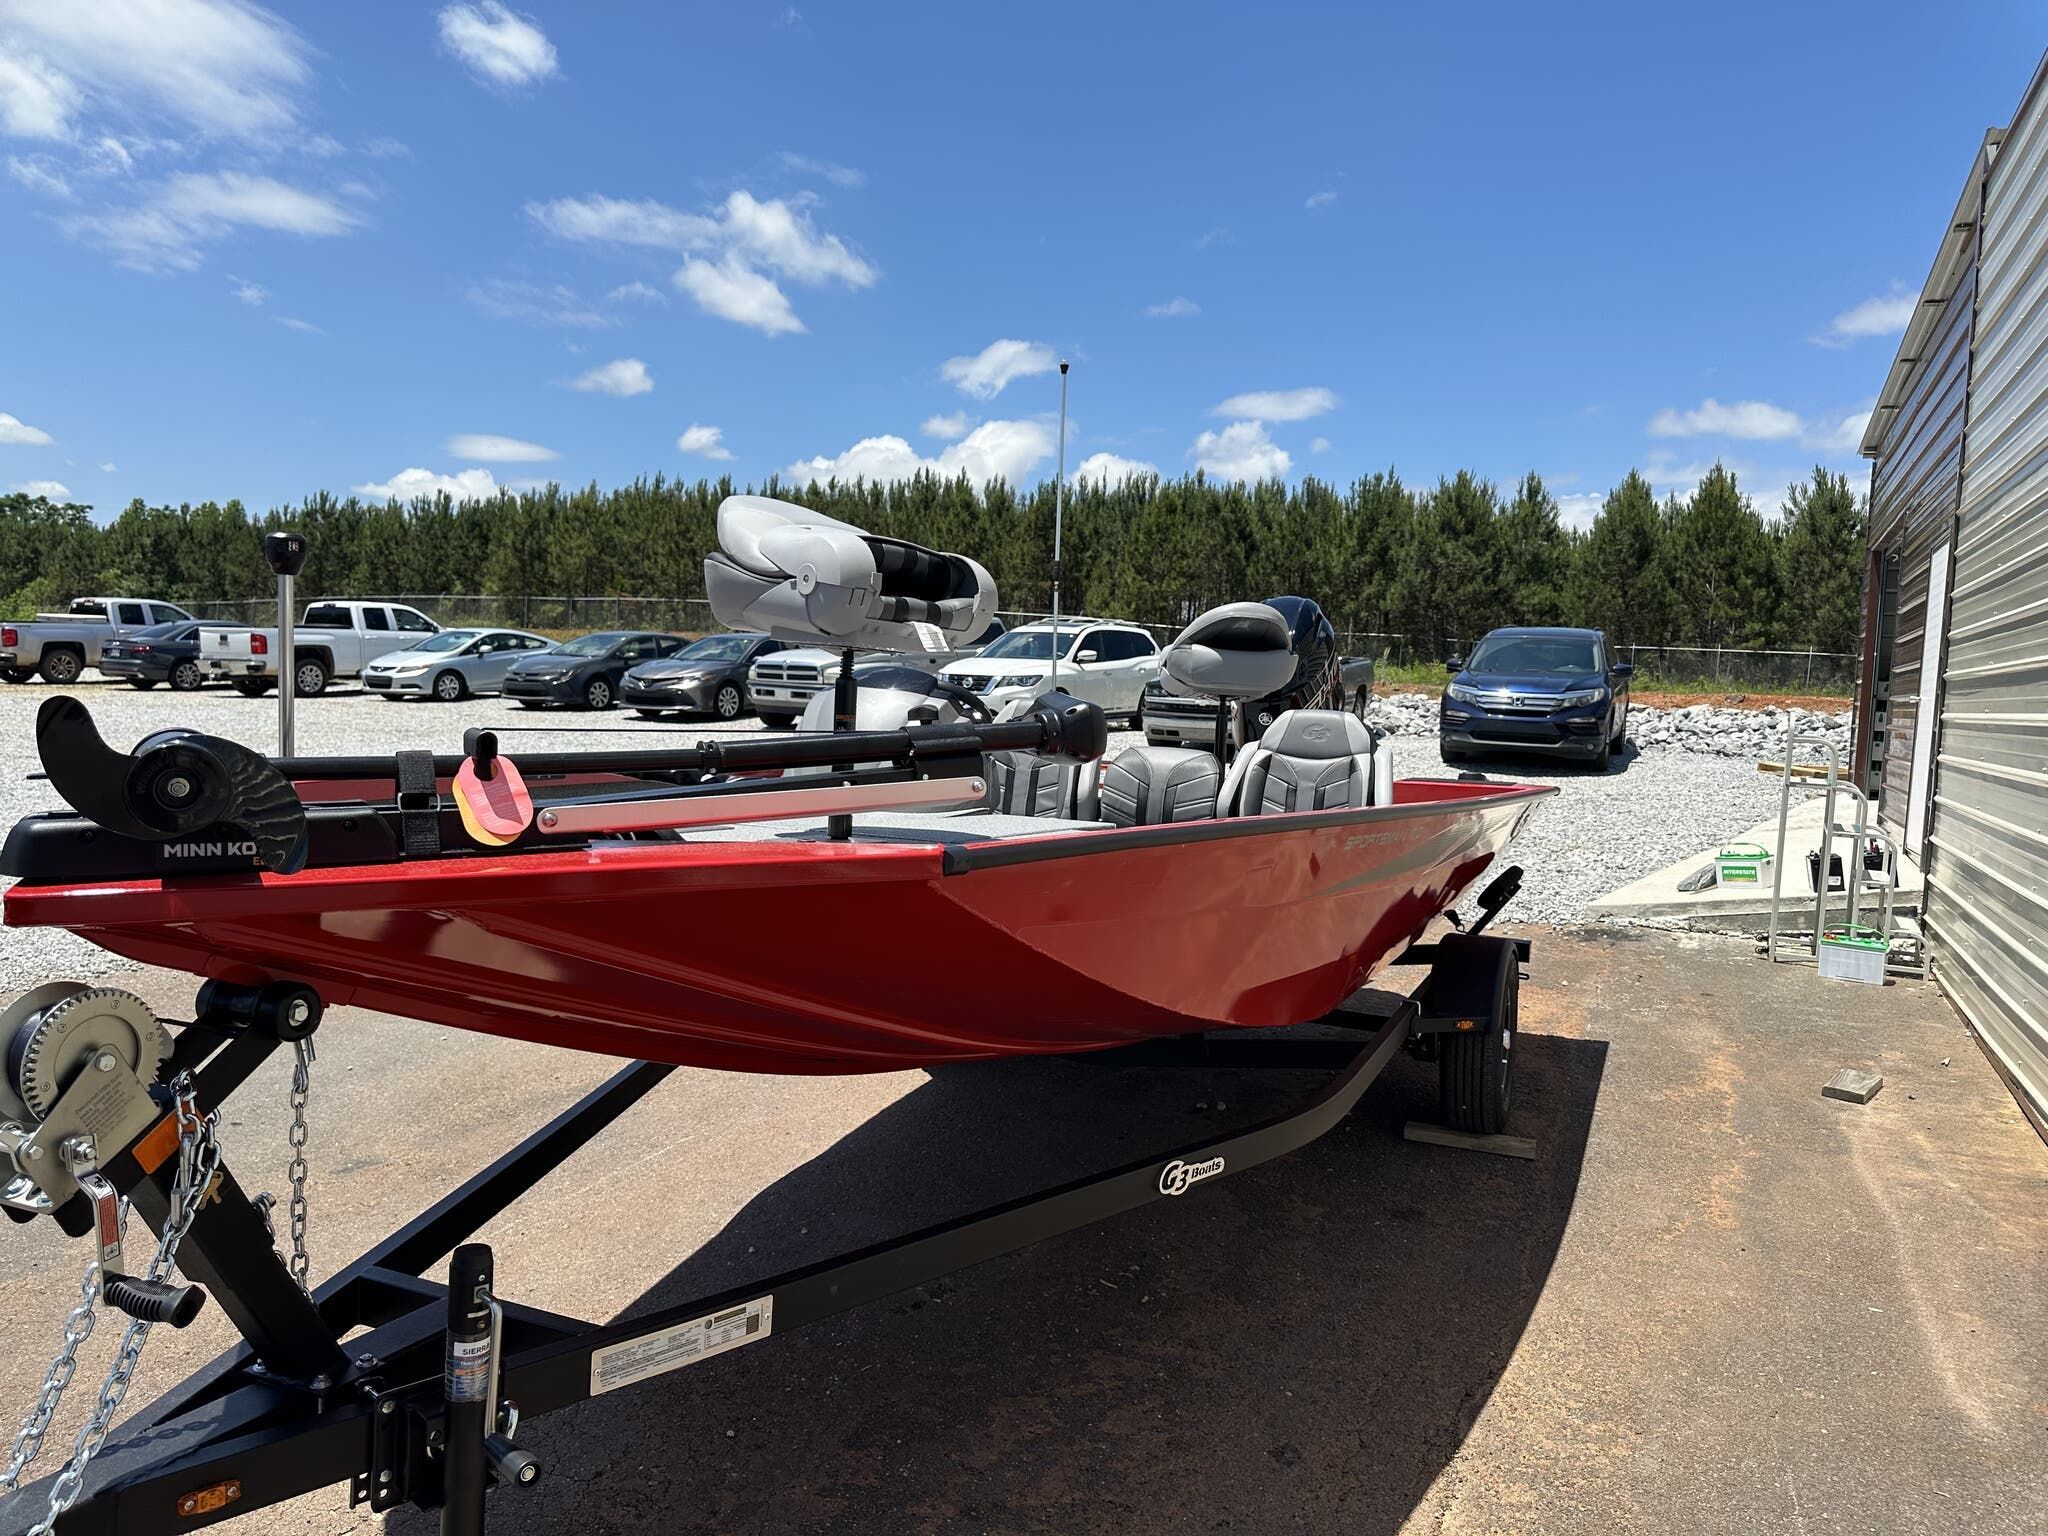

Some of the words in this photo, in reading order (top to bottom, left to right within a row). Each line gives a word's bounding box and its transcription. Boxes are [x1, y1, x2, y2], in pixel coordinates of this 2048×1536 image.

[163, 842, 222, 858] MINN
[227, 841, 257, 856] KO
[1161, 1162, 1190, 1192] G3
[1191, 1160, 1221, 1179] Boats
[462, 1343, 491, 1356] SIERRA
